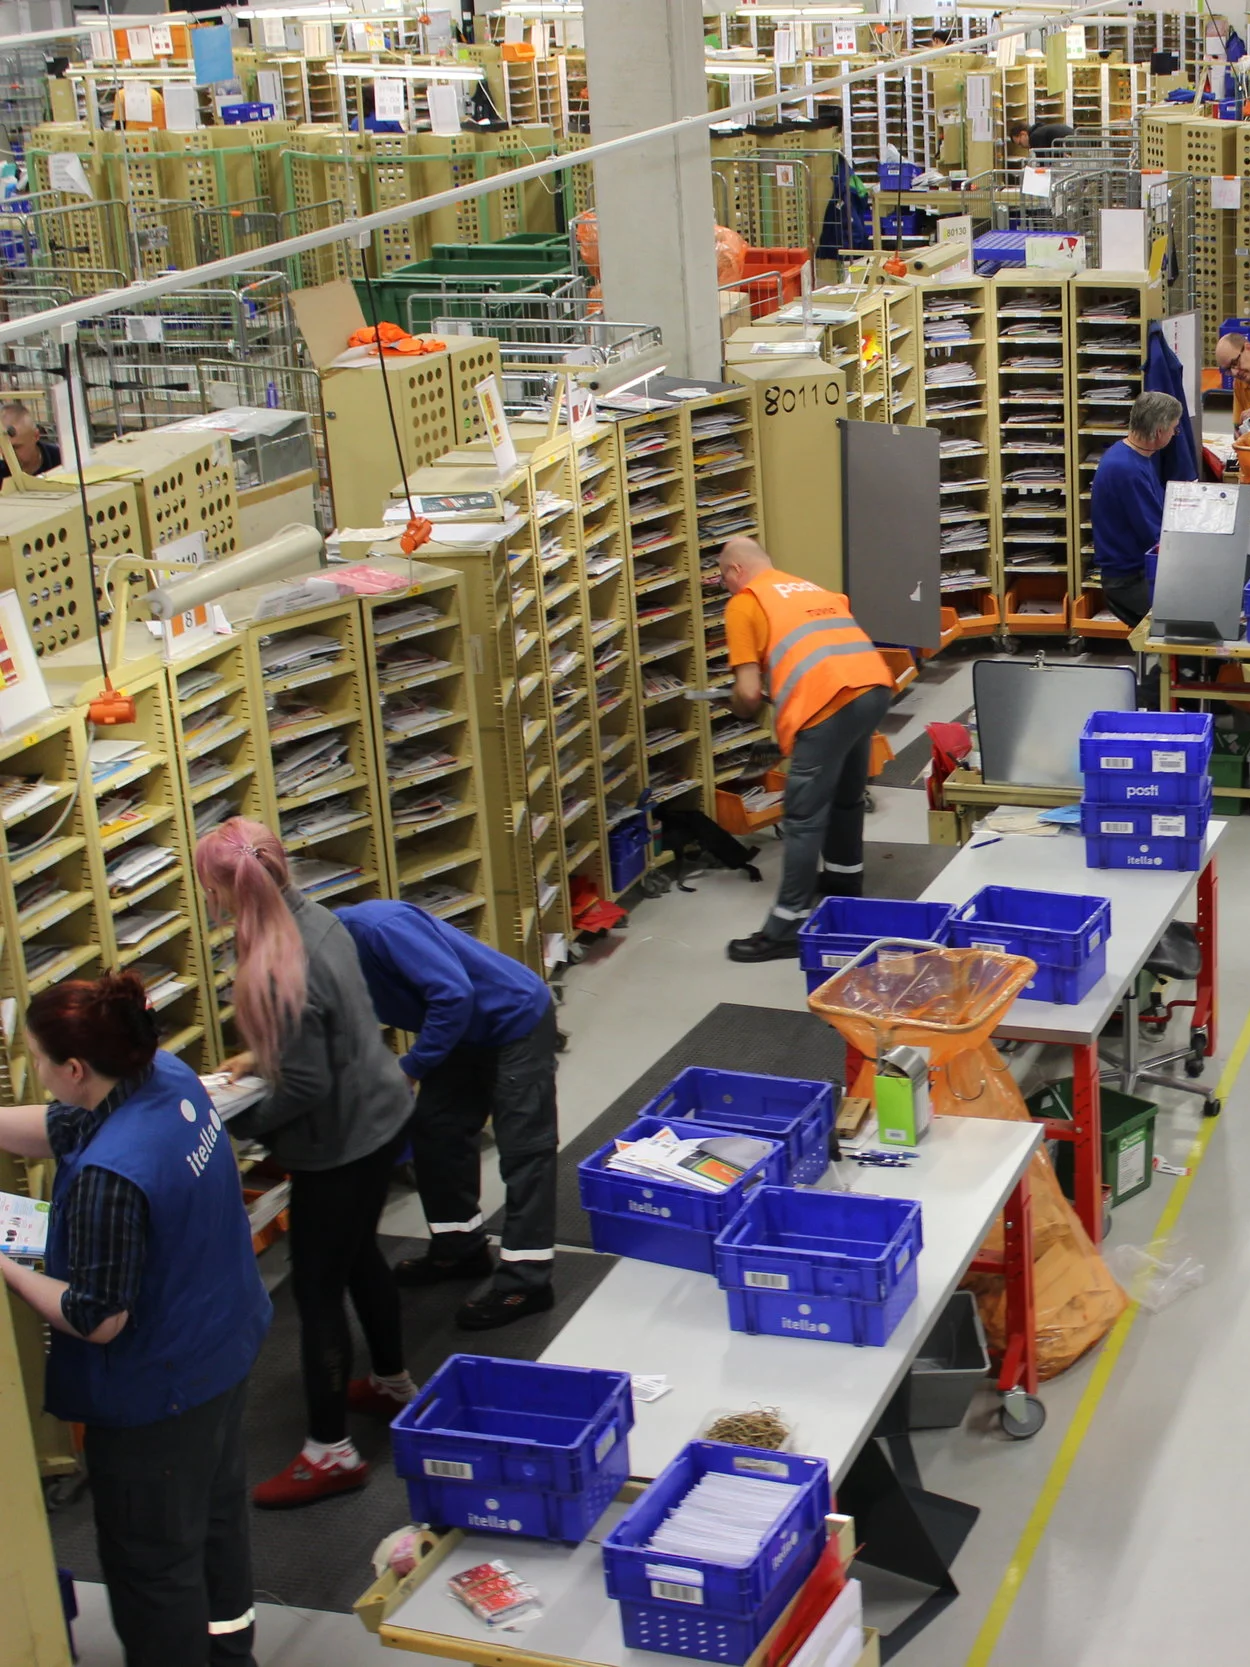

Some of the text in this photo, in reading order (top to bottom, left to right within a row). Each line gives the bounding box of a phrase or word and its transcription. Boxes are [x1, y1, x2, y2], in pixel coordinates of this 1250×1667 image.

[946, 227, 967, 238] 80130
[764, 381, 840, 416] 80110
[185, 610, 193, 628] 8
[1127, 784, 1159, 799] posti
[1128, 855, 1154, 865] itella
[185, 1125, 217, 1178] itella
[629, 1199, 660, 1215] itella
[782, 1316, 817, 1332] itella
[468, 1512, 509, 1530] itella
